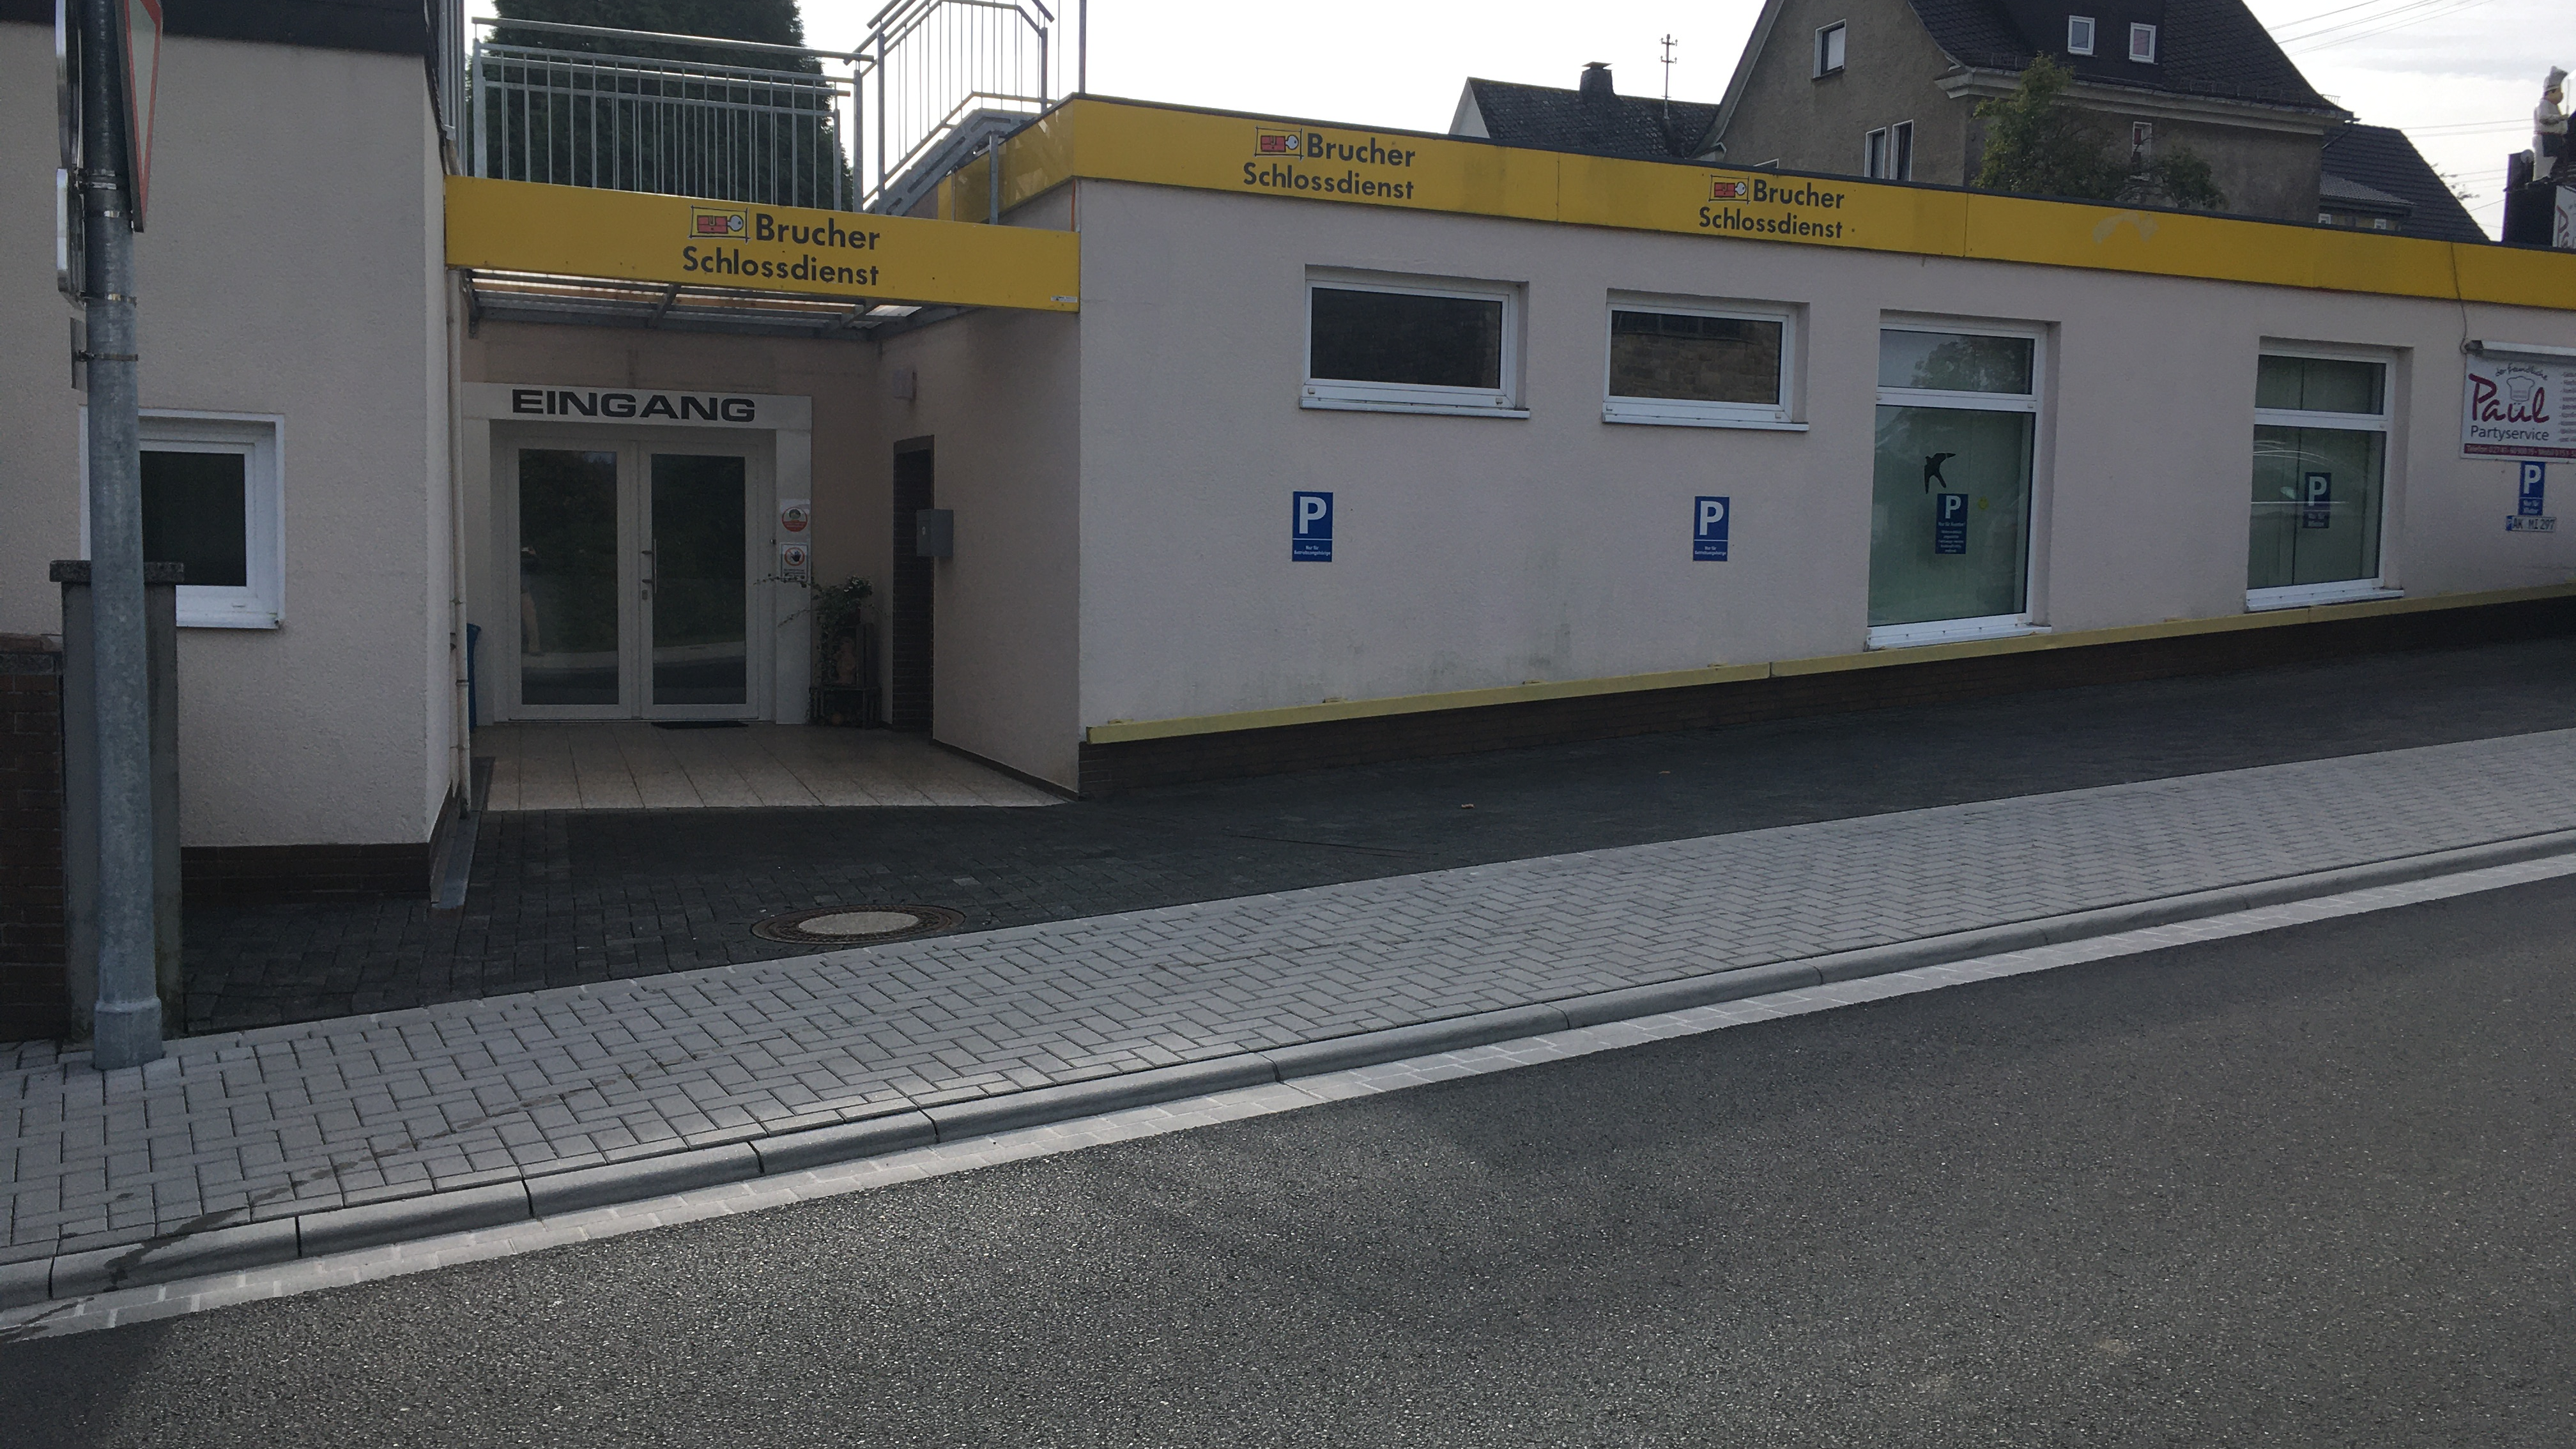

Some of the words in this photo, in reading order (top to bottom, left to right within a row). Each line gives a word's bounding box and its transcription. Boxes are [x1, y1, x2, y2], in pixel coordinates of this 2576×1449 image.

[1308, 133, 1415, 167] Brucher
[1243, 162, 1414, 199] Schlossdienst
[1754, 180, 1844, 208] Brucher
[756, 213, 880, 250] Brucher
[1699, 206, 1843, 238] Schlossdienst
[682, 246, 879, 286] Schlossdienst
[512, 389, 755, 422] EINGANG
[2468, 373, 2550, 423] Paul
[2471, 425, 2550, 441] Partyservice
[2308, 476, 2327, 506] P
[2524, 464, 2542, 494] P
[1299, 496, 1326, 534] P
[1699, 501, 1724, 535] P
[1945, 495, 1961, 519] P
